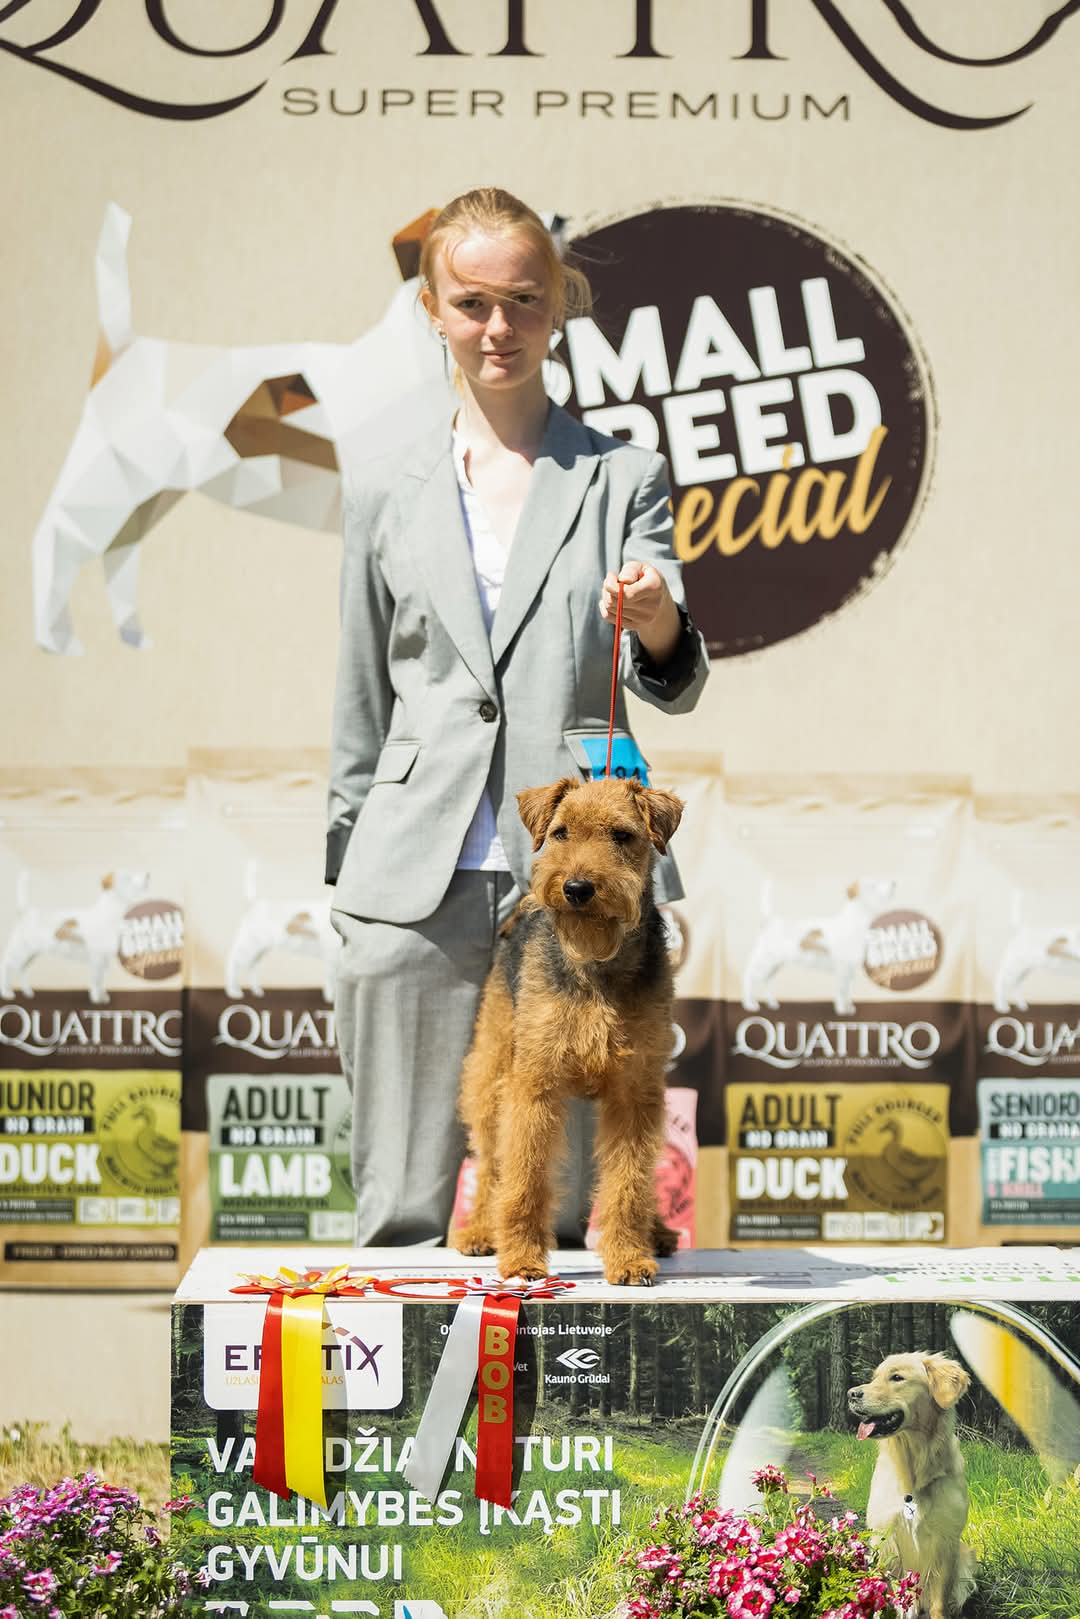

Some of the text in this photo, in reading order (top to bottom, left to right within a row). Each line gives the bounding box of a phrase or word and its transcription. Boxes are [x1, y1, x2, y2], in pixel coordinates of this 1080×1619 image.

[282, 87, 851, 122] SUPER PREMIUM
[668, 425, 892, 563] ecial
[731, 1016, 941, 1069] QUATTRO
[222, 1086, 330, 1121] ADULT
[740, 1093, 841, 1127] ADULT
[5, 1116, 84, 1133] NO GRAIN
[229, 1126, 317, 1145] NO GRAIN
[745, 1129, 829, 1149] NO GRAIN
[219, 1153, 332, 1198] LAMB
[736, 1157, 849, 1200] DUCK
[558, 1324, 613, 1337] Lietuvoje
[482, 1325, 510, 1424] BOB
[545, 1374, 577, 1384] Kauno
[456, 1435, 614, 1473] NTURI
[207, 1536, 403, 1581] GYVŪNUI
